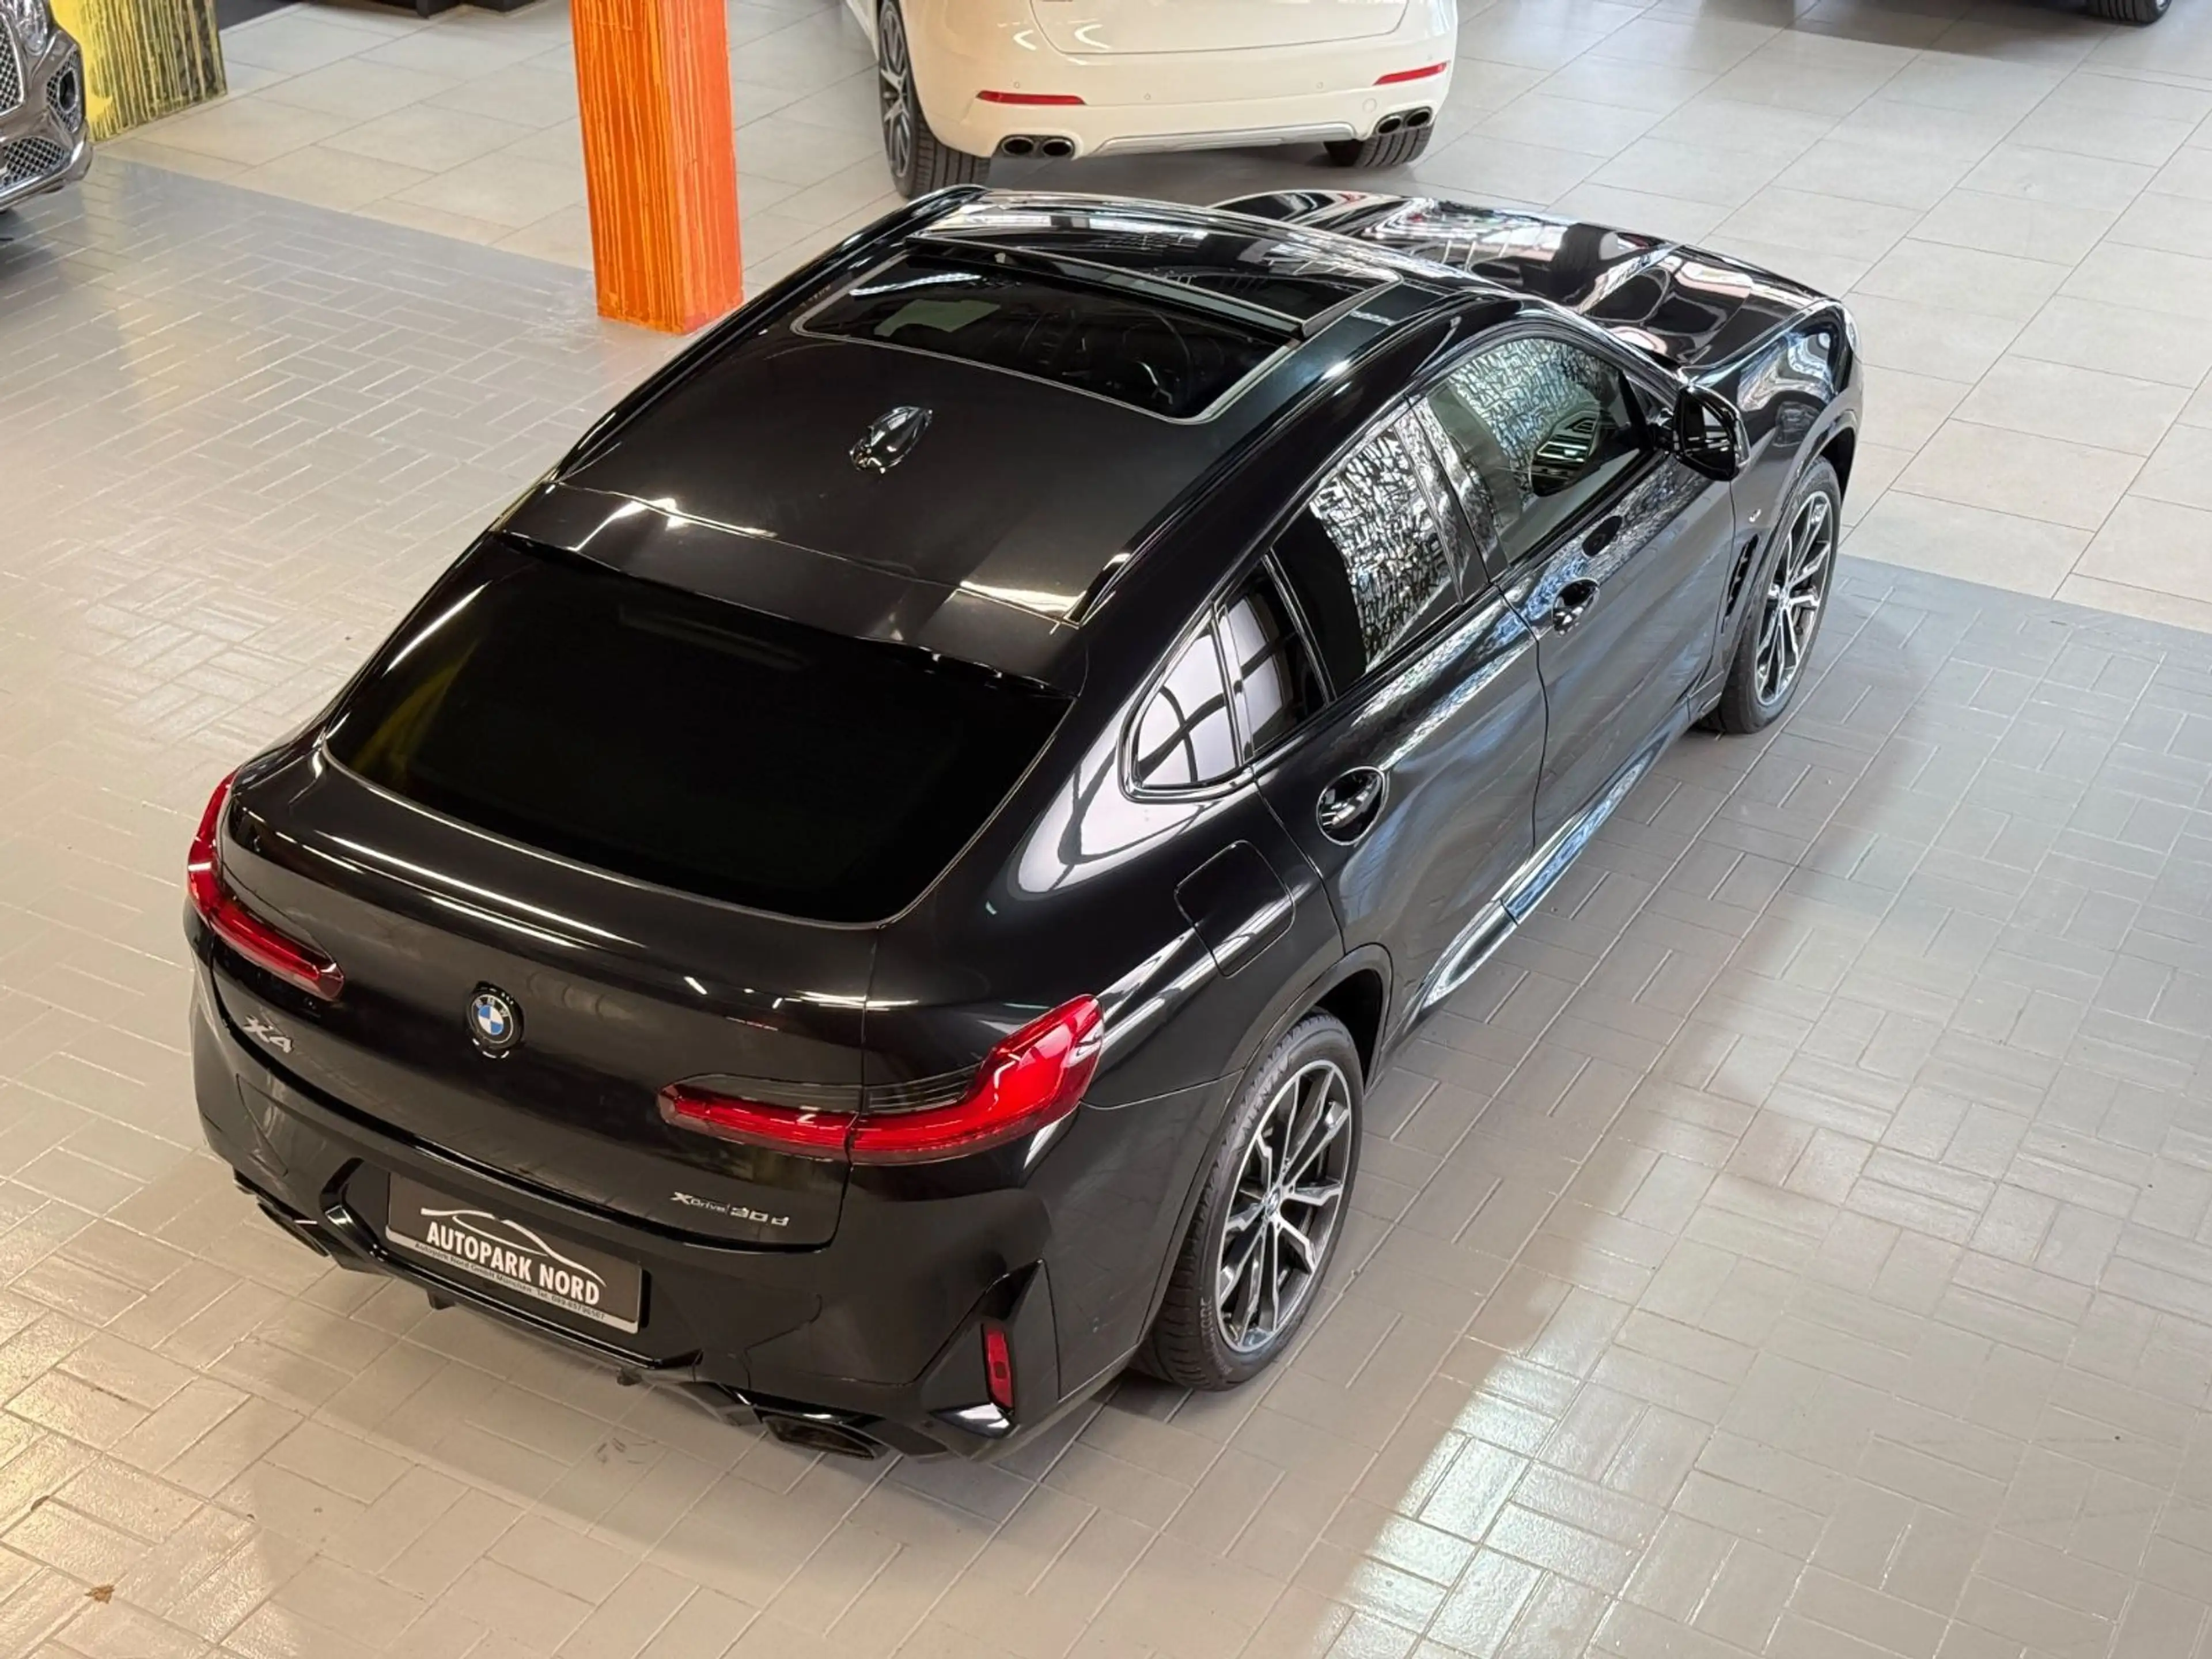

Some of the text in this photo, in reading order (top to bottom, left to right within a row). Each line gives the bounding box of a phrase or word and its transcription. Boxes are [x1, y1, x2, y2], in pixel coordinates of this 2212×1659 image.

[243, 1014, 292, 1053] X4
[426, 1221, 600, 1305] AUTOPARK NORD
